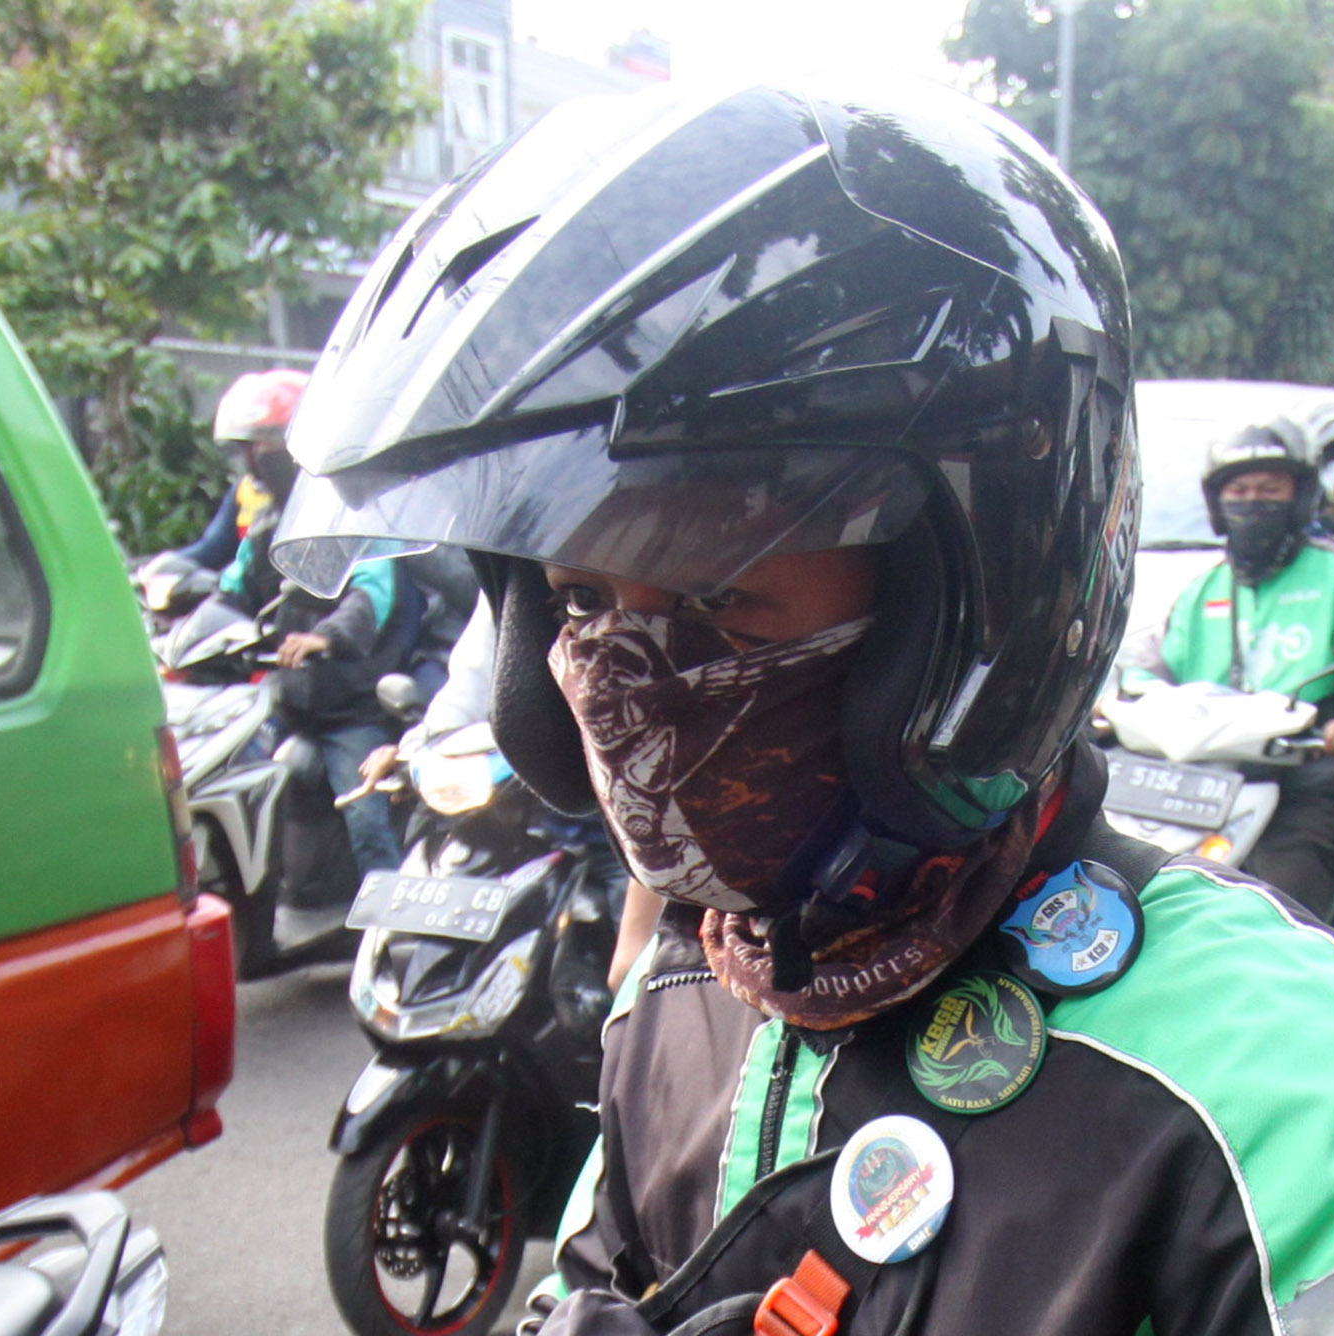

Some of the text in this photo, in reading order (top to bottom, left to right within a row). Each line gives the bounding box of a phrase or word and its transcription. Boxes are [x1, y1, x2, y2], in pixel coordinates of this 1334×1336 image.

[359, 876, 505, 912] F 6486 CB
[919, 996, 959, 1054] KBGB
[951, 999, 969, 1026] RAYA
